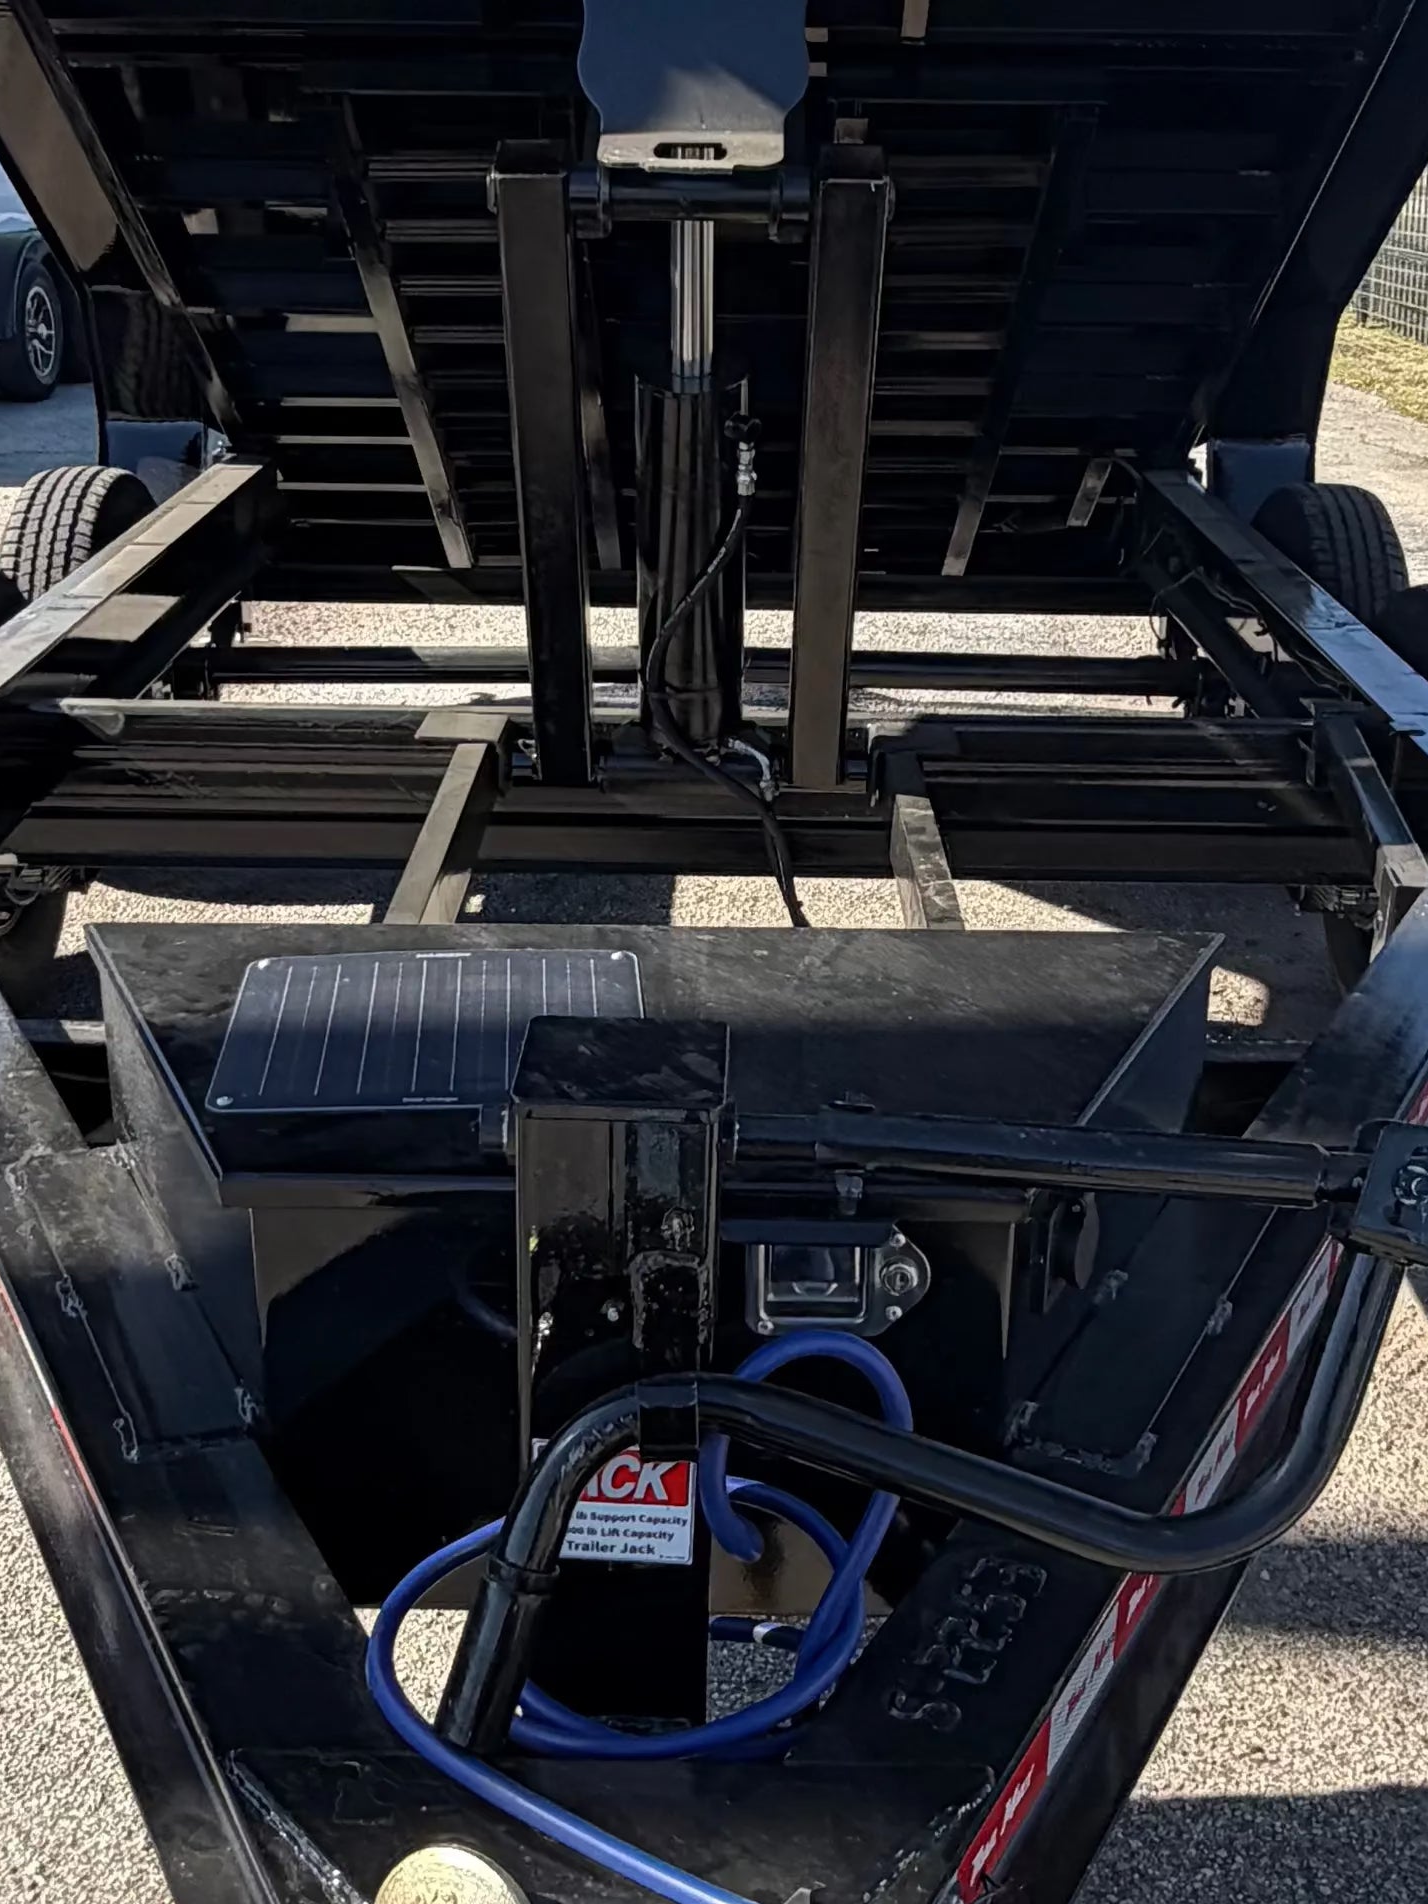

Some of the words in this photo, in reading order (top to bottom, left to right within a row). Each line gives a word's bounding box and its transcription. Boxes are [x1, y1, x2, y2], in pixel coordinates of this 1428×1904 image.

[590, 1512, 636, 1524] Support
[639, 1514, 688, 1527] Capacity
[601, 1527, 620, 1537] Lift
[623, 1529, 675, 1542] Capacity
[566, 1540, 617, 1553] Trailer
[620, 1542, 655, 1555] Jack
